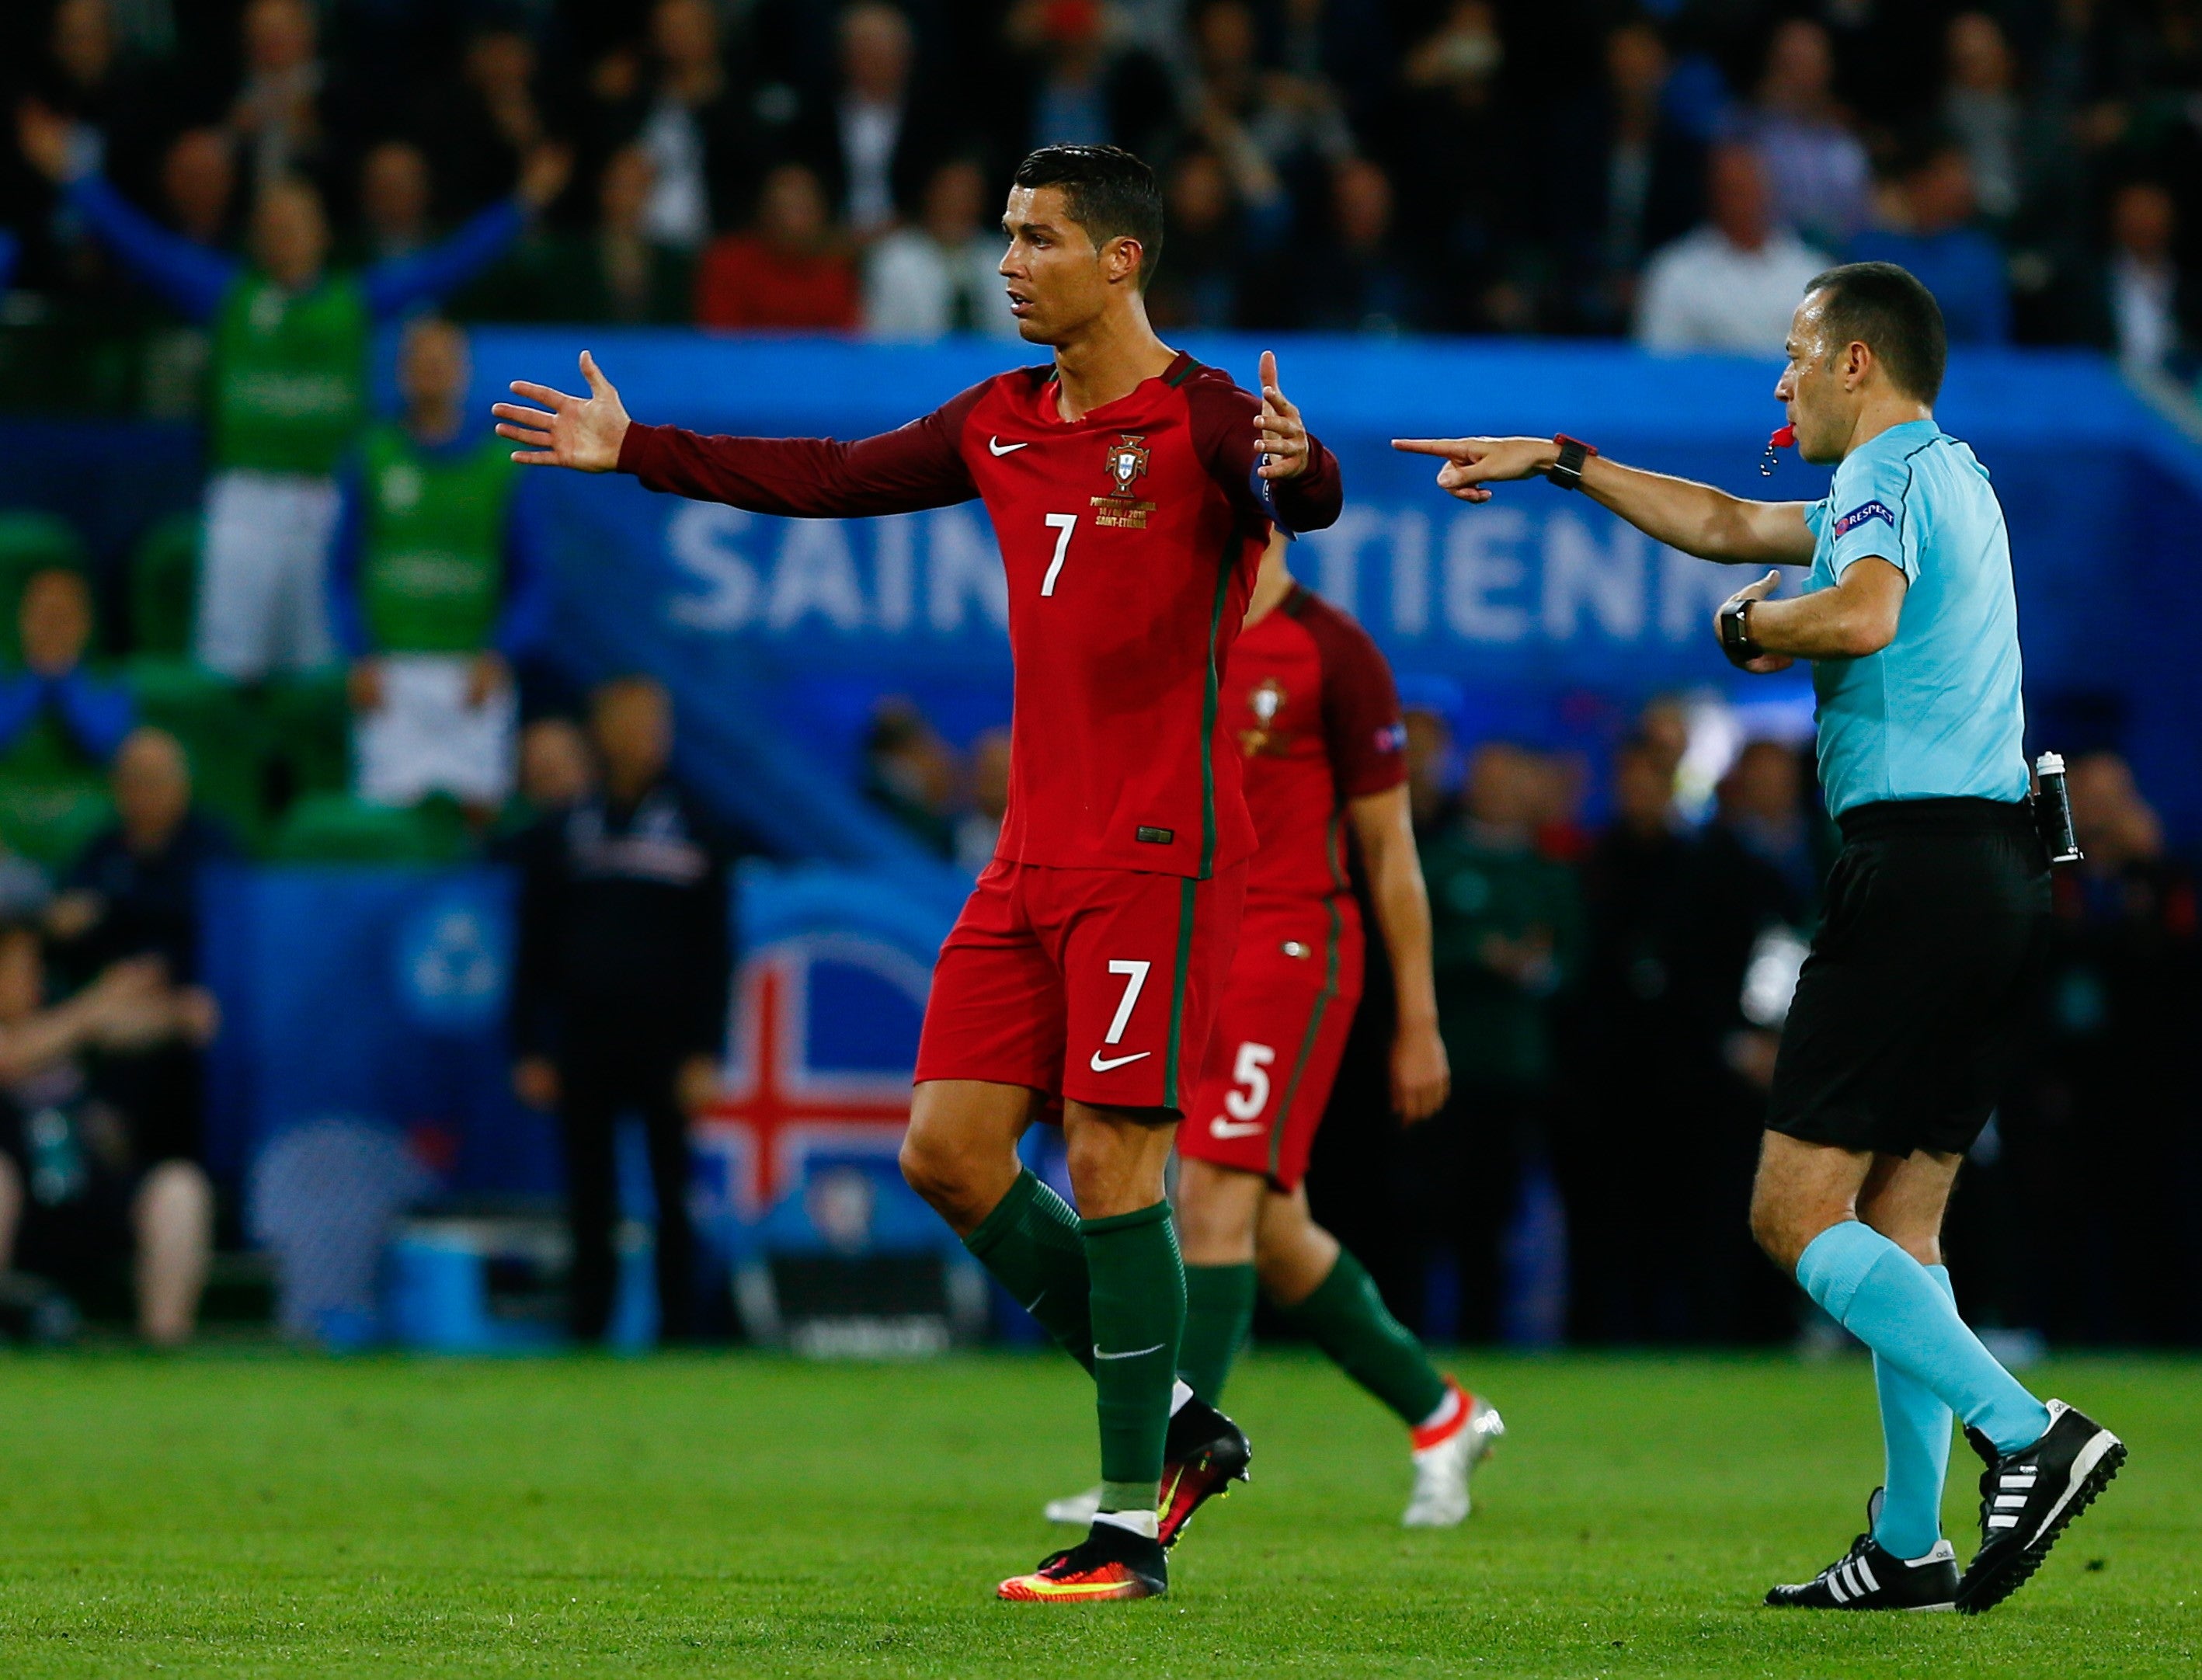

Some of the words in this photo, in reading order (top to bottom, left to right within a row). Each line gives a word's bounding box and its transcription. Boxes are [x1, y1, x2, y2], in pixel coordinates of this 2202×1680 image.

[1041, 513, 1077, 596] 7
[1849, 504, 1894, 525] RESPECT
[666, 499, 1010, 631] SAIN
[1104, 960, 1151, 1044] 7
[1224, 1041, 1275, 1121] 5
